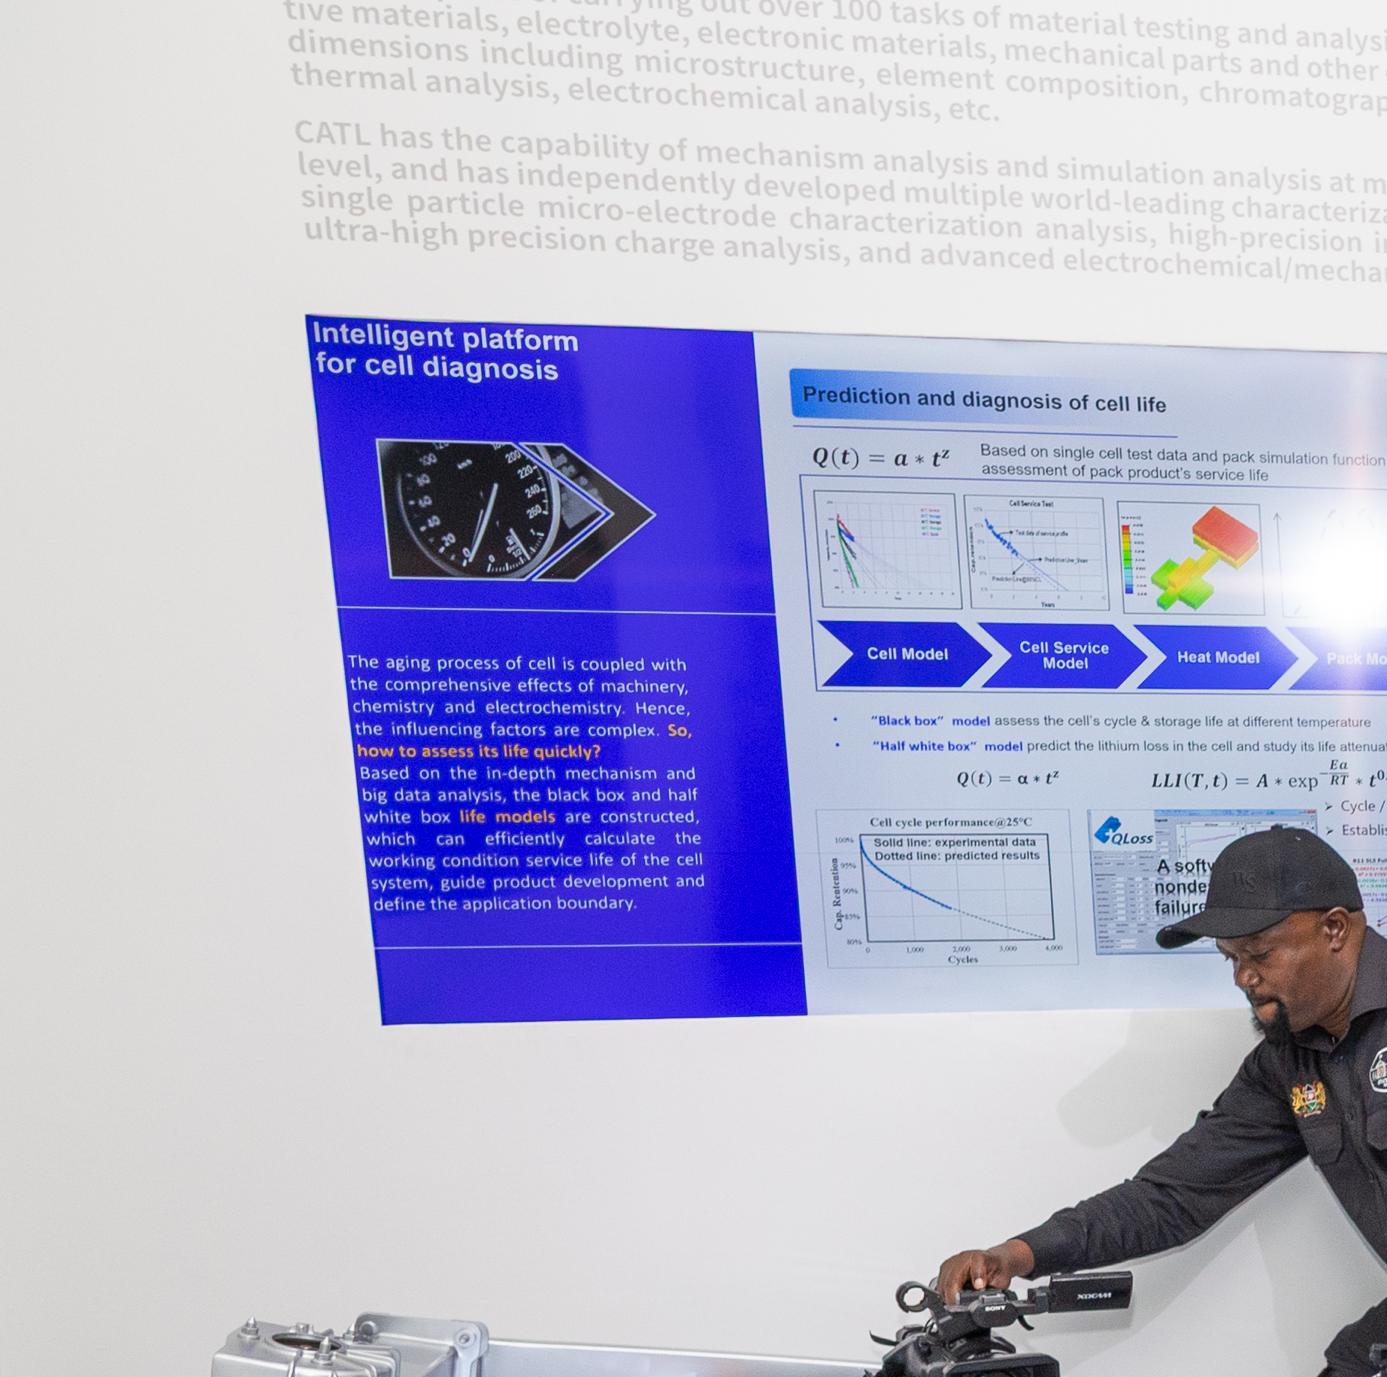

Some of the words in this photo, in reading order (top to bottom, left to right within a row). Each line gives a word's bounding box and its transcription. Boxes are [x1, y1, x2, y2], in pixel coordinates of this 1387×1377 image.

[304, 217, 459, 252] ultra-high
[468, 225, 606, 253] precision
[615, 229, 715, 263] charge
[723, 235, 851, 268] analysis,
[859, 240, 911, 265] and
[920, 242, 1055, 270] advanced
[313, 321, 455, 352] Intelligent
[462, 327, 579, 354] platform
[315, 351, 357, 374] for
[365, 354, 414, 376] cell
[422, 355, 559, 384] diagnosis
[802, 385, 911, 406] Prediction
[917, 390, 956, 407] and
[962, 390, 1063, 413] diagnosis
[1069, 394, 1089, 411] of
[1095, 395, 1130, 412] cell
[1136, 396, 1167, 413] life
[867, 646, 897, 660] Cell
[901, 647, 949, 661] Model
[1019, 640, 1049, 654] Cell
[1053, 641, 1110, 655] Service
[347, 654, 379, 669] The
[386, 657, 431, 673] aging
[437, 658, 500, 673] process
[505, 655, 522, 671] of
[528, 656, 556, 671] cell
[562, 656, 575, 671] is
[580, 657, 645, 674] coupled
[650, 657, 687, 672] with
[1043, 656, 1089, 670] Model
[1177, 650, 1212, 664] Heat
[1215, 650, 1260, 664] Model
[1327, 652, 1362, 665] Pack
[356, 743, 395, 758] how
[398, 745, 417, 758] to
[421, 746, 475, 759] assess
[478, 744, 499, 759] its
[502, 743, 529, 758] life
[533, 744, 601, 761] quickly?
[1340, 799, 1376, 815] Cycle
[869, 817, 893, 828] Cell
[895, 817, 922, 830] cycle
[873, 837, 904, 848] Solid
[906, 837, 933, 849] line:
[934, 837, 1009, 849] experimental
[1011, 837, 1037, 847] data
[1111, 832, 1154, 846] QLoss
[984, 1304, 1007, 1312] SONY
